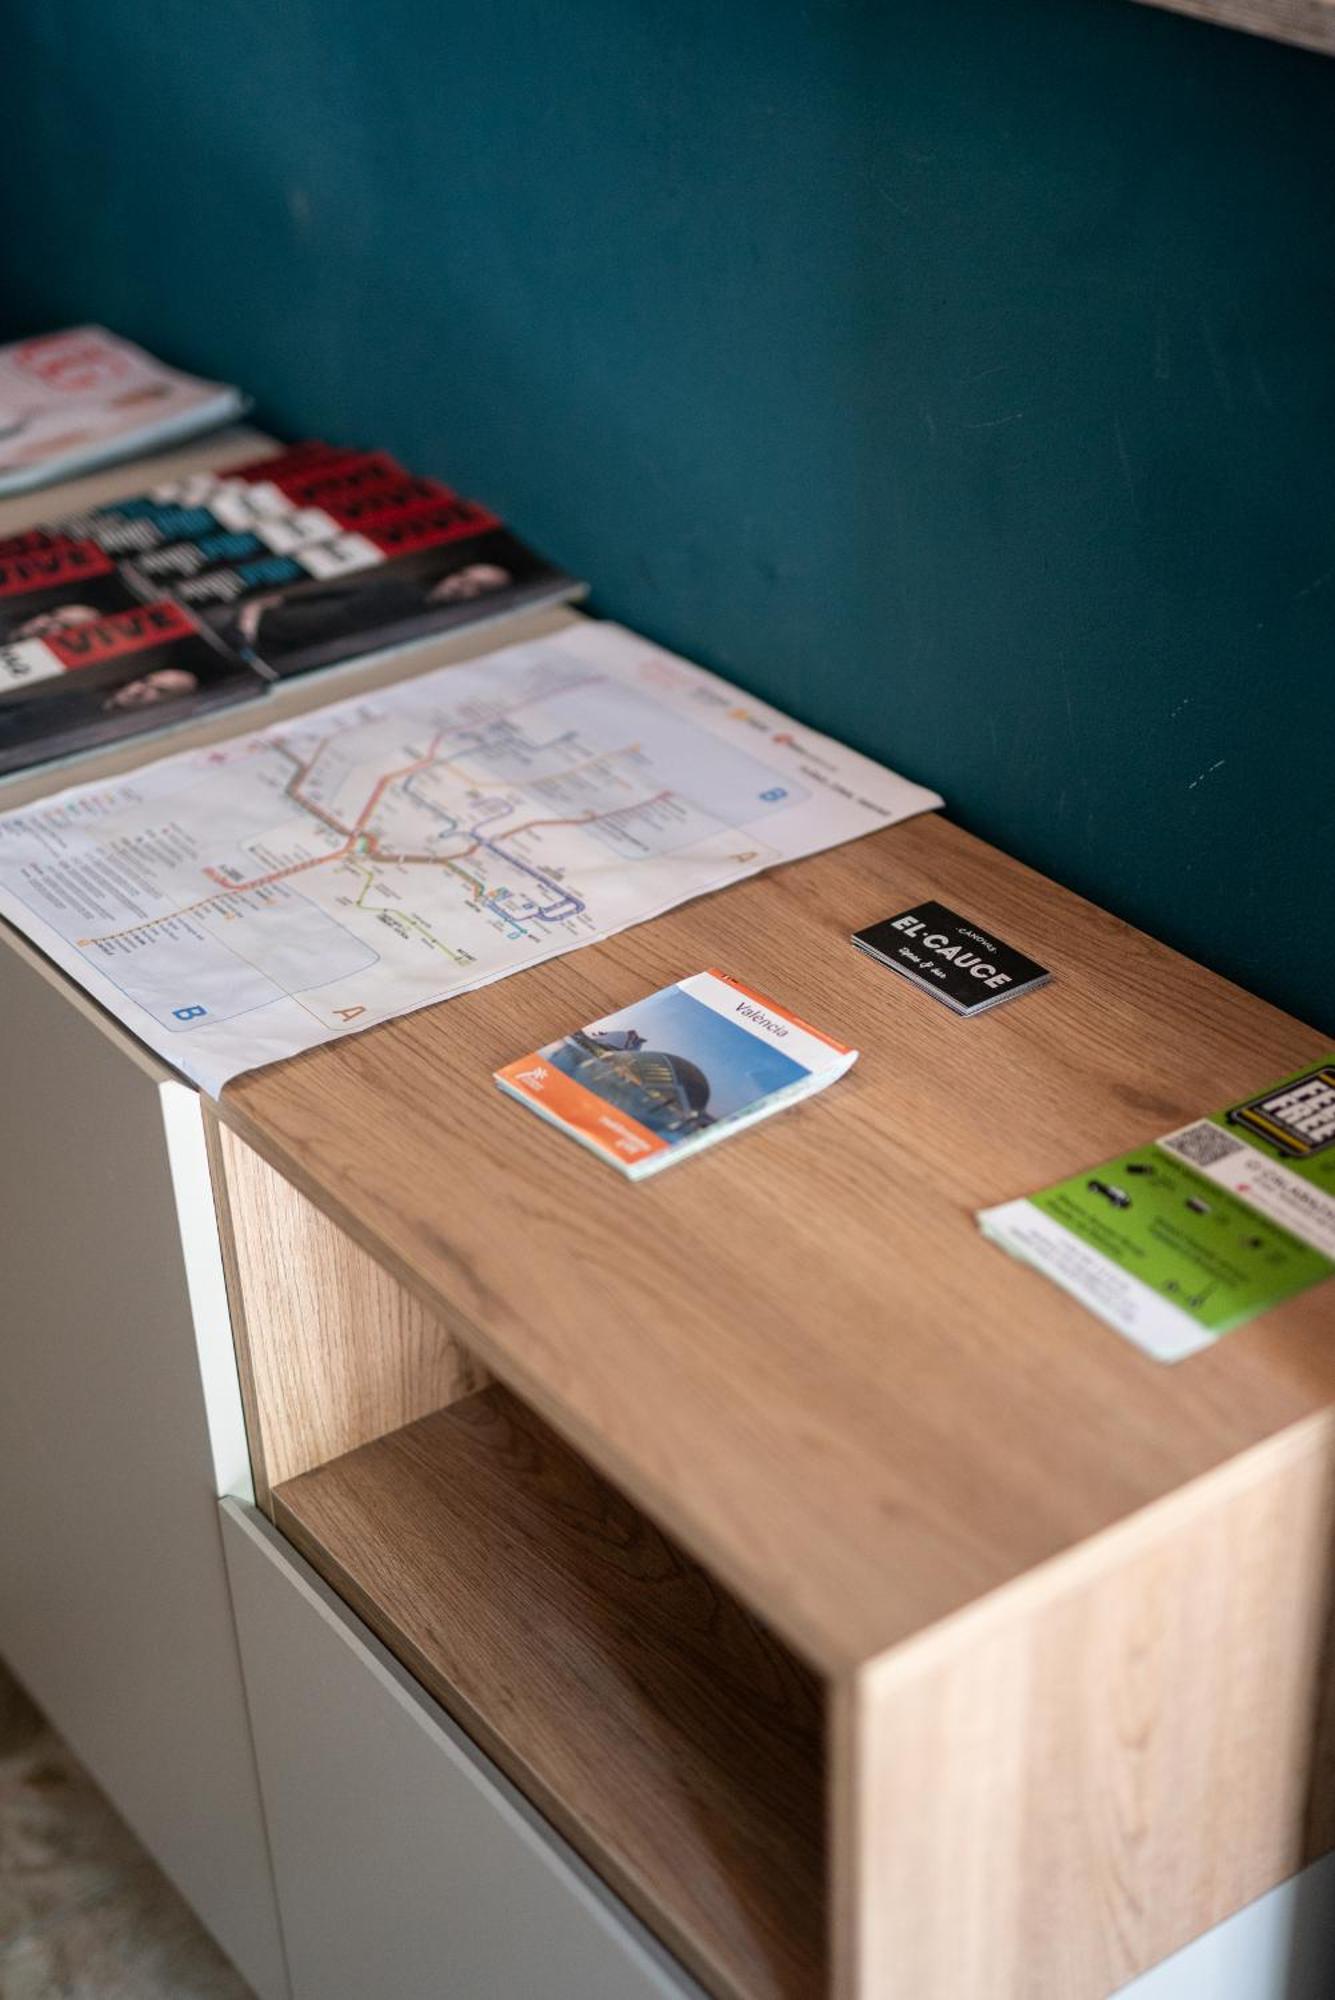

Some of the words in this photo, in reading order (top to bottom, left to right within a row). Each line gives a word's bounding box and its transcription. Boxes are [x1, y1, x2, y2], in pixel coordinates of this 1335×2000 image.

[172, 1005, 207, 1021] B
[332, 1005, 366, 1022] A
[736, 1002, 789, 1037] València
